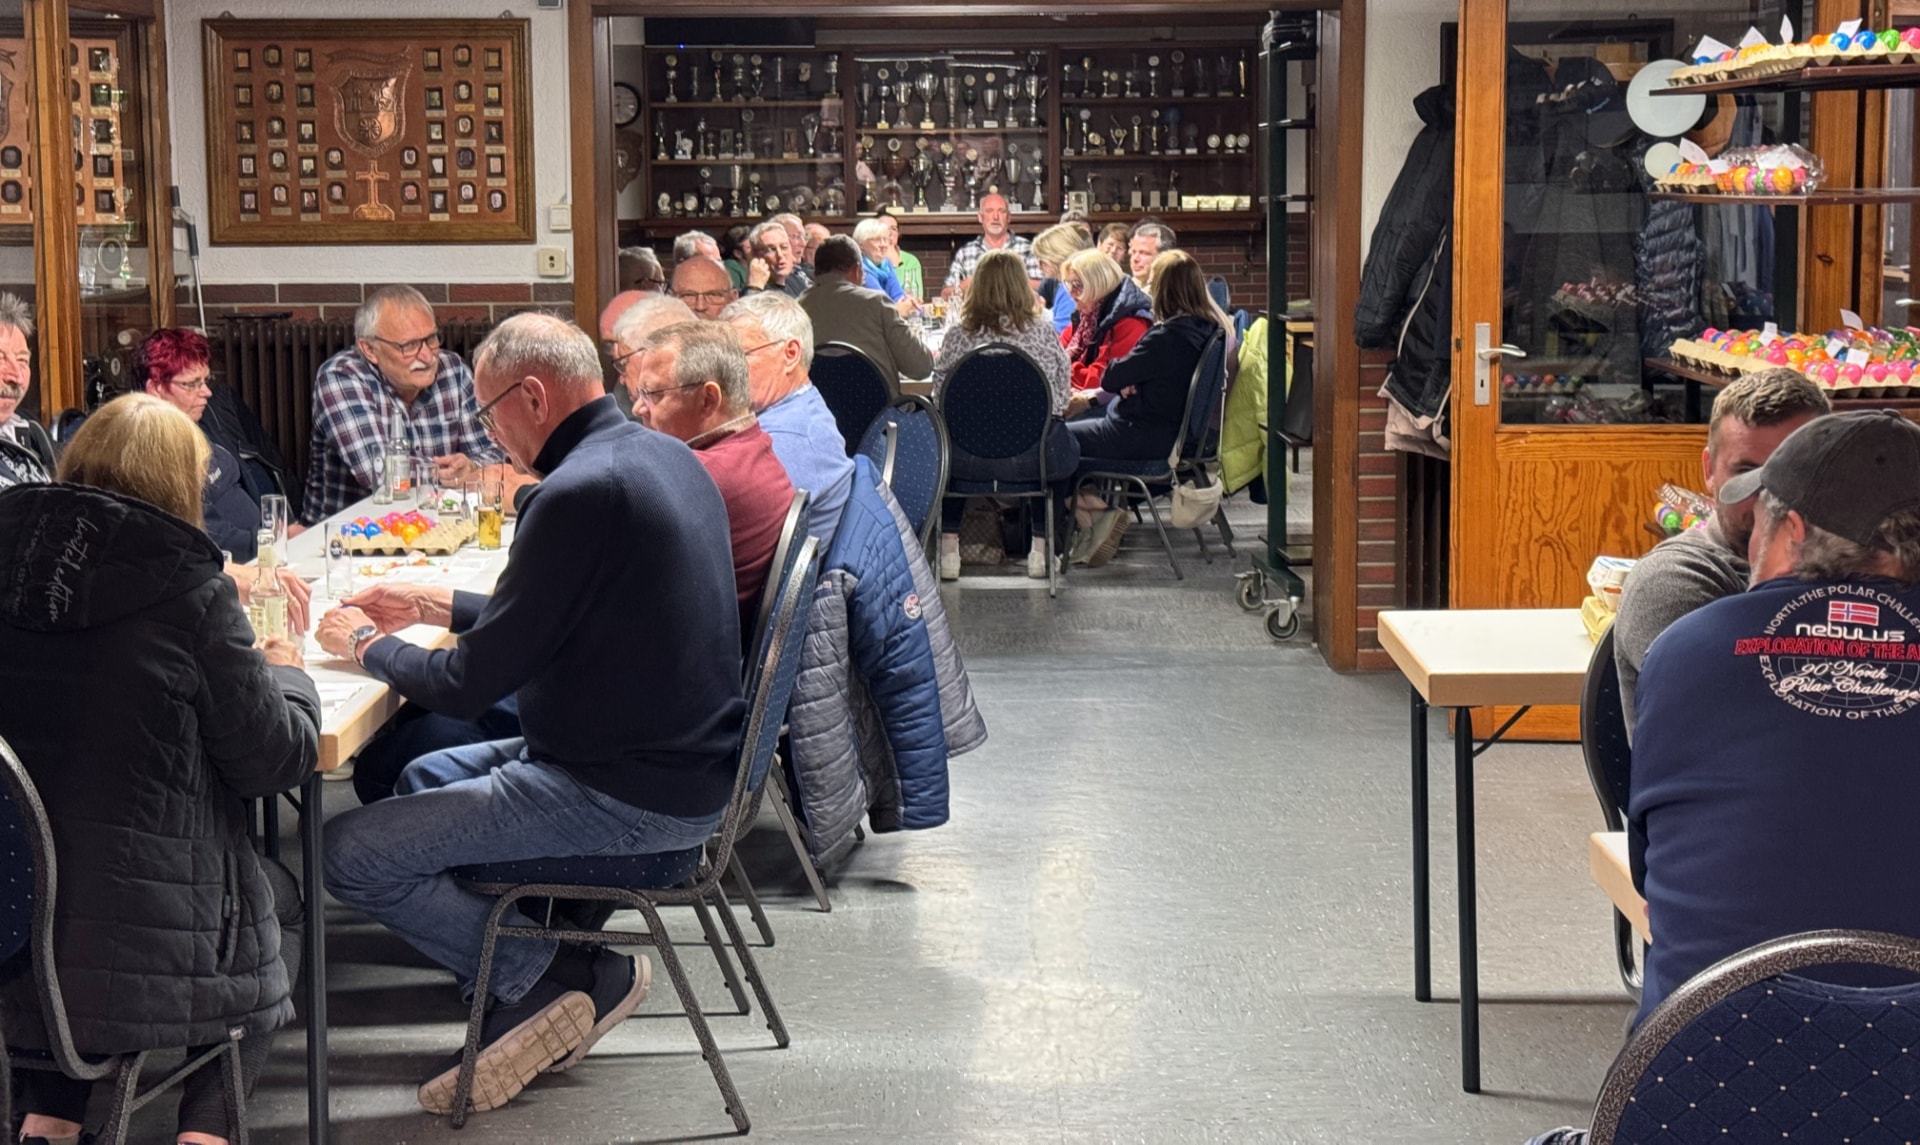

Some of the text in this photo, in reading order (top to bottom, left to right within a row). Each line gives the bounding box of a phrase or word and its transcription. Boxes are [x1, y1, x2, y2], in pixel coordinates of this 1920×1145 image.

[1828, 584, 1876, 599] POLAR
[1734, 637, 1845, 656] EXPLORATION
[1847, 642, 1871, 659] OF
[1872, 642, 1906, 660] THE
[1831, 660, 1889, 680] North
[1759, 655, 1841, 718] EXPLORATION
[1846, 710, 1869, 719] OF
[1873, 703, 1906, 718] THE
[1780, 675, 1920, 703] Polar Challenge
